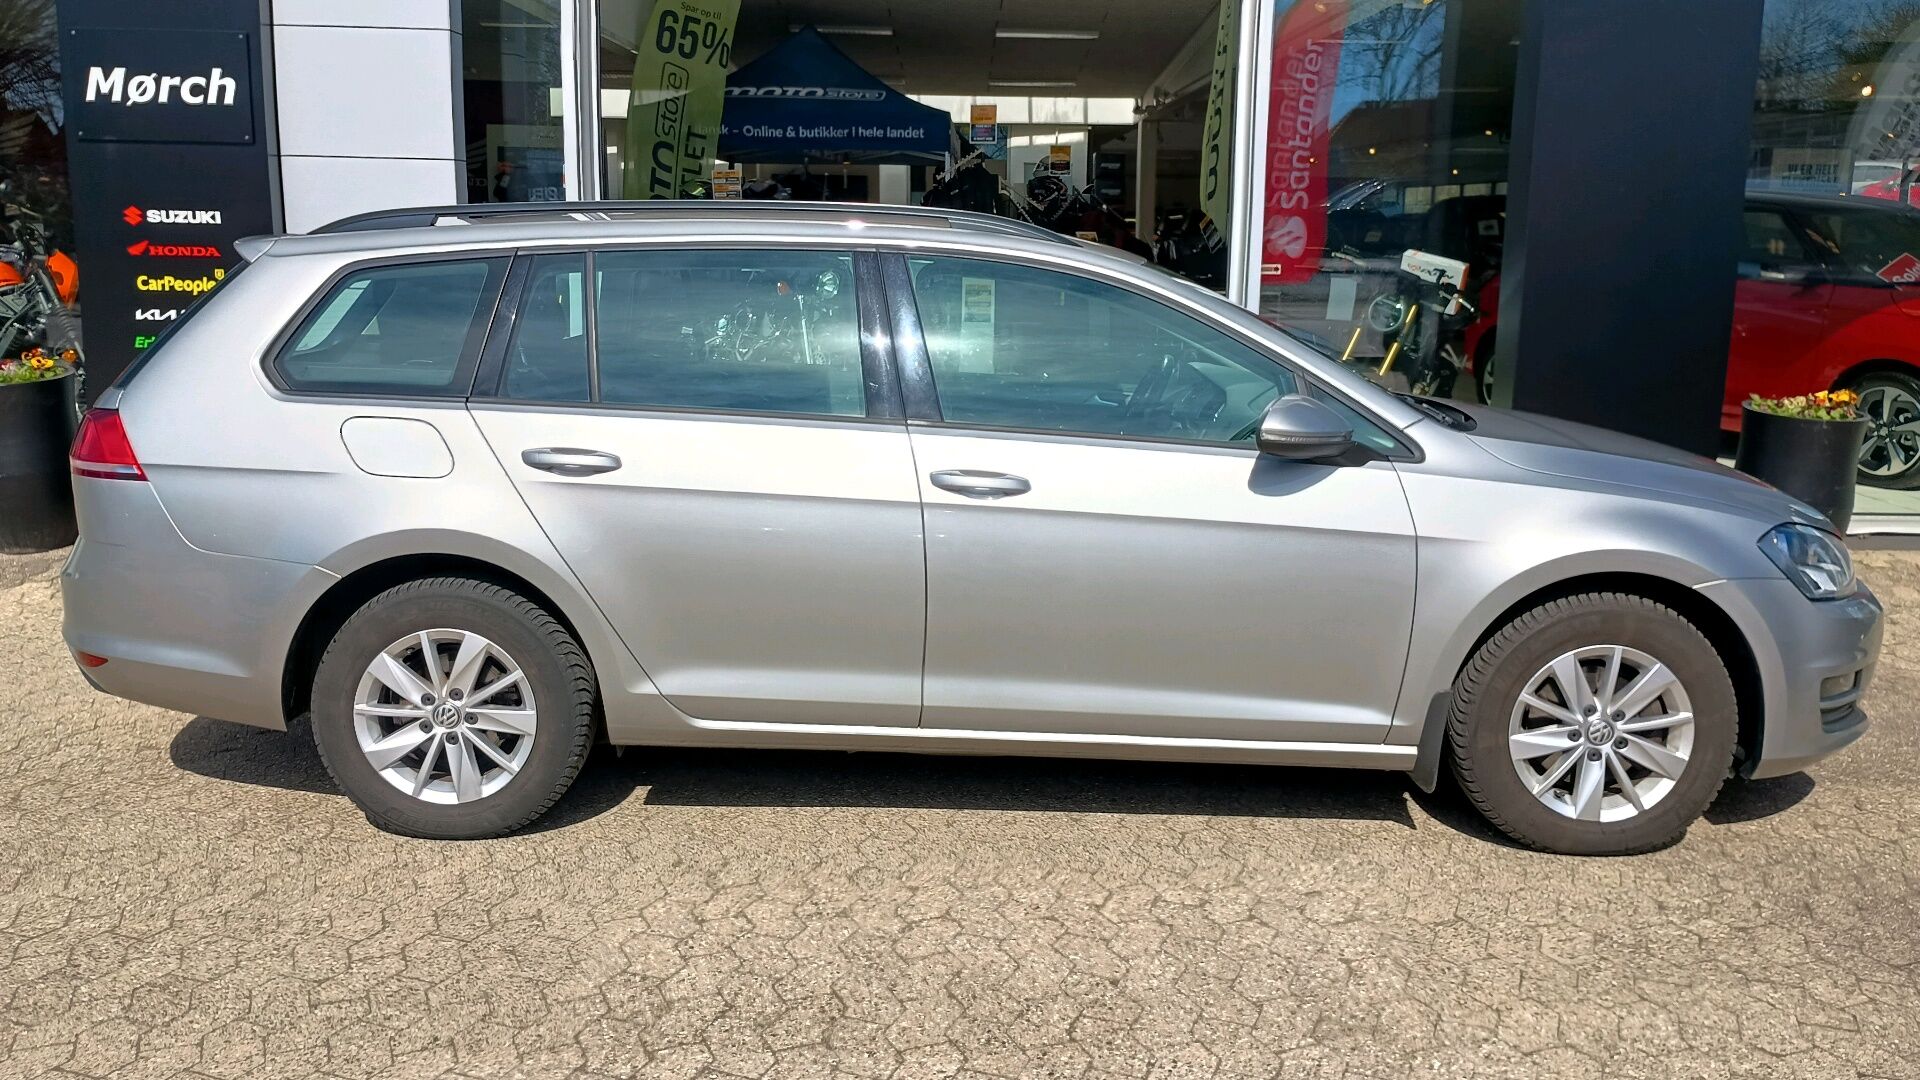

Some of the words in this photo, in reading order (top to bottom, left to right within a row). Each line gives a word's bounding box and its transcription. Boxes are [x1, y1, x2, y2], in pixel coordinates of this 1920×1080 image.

[681, 2, 699, 14] Spar
[701, 9, 711, 19] op
[713, 12, 722, 21] til
[656, 9, 730, 69] 65%
[85, 66, 236, 107] Mørch
[742, 125, 783, 138] Online
[786, 126, 796, 138] &
[799, 126, 849, 138] butikker
[858, 126, 884, 138] hele
[887, 126, 925, 138] landet
[1281, 39, 1324, 209] Santander
[146, 209, 222, 225] SUZUKI
[148, 246, 222, 257] HONDA
[136, 275, 217, 296] CarPeople
